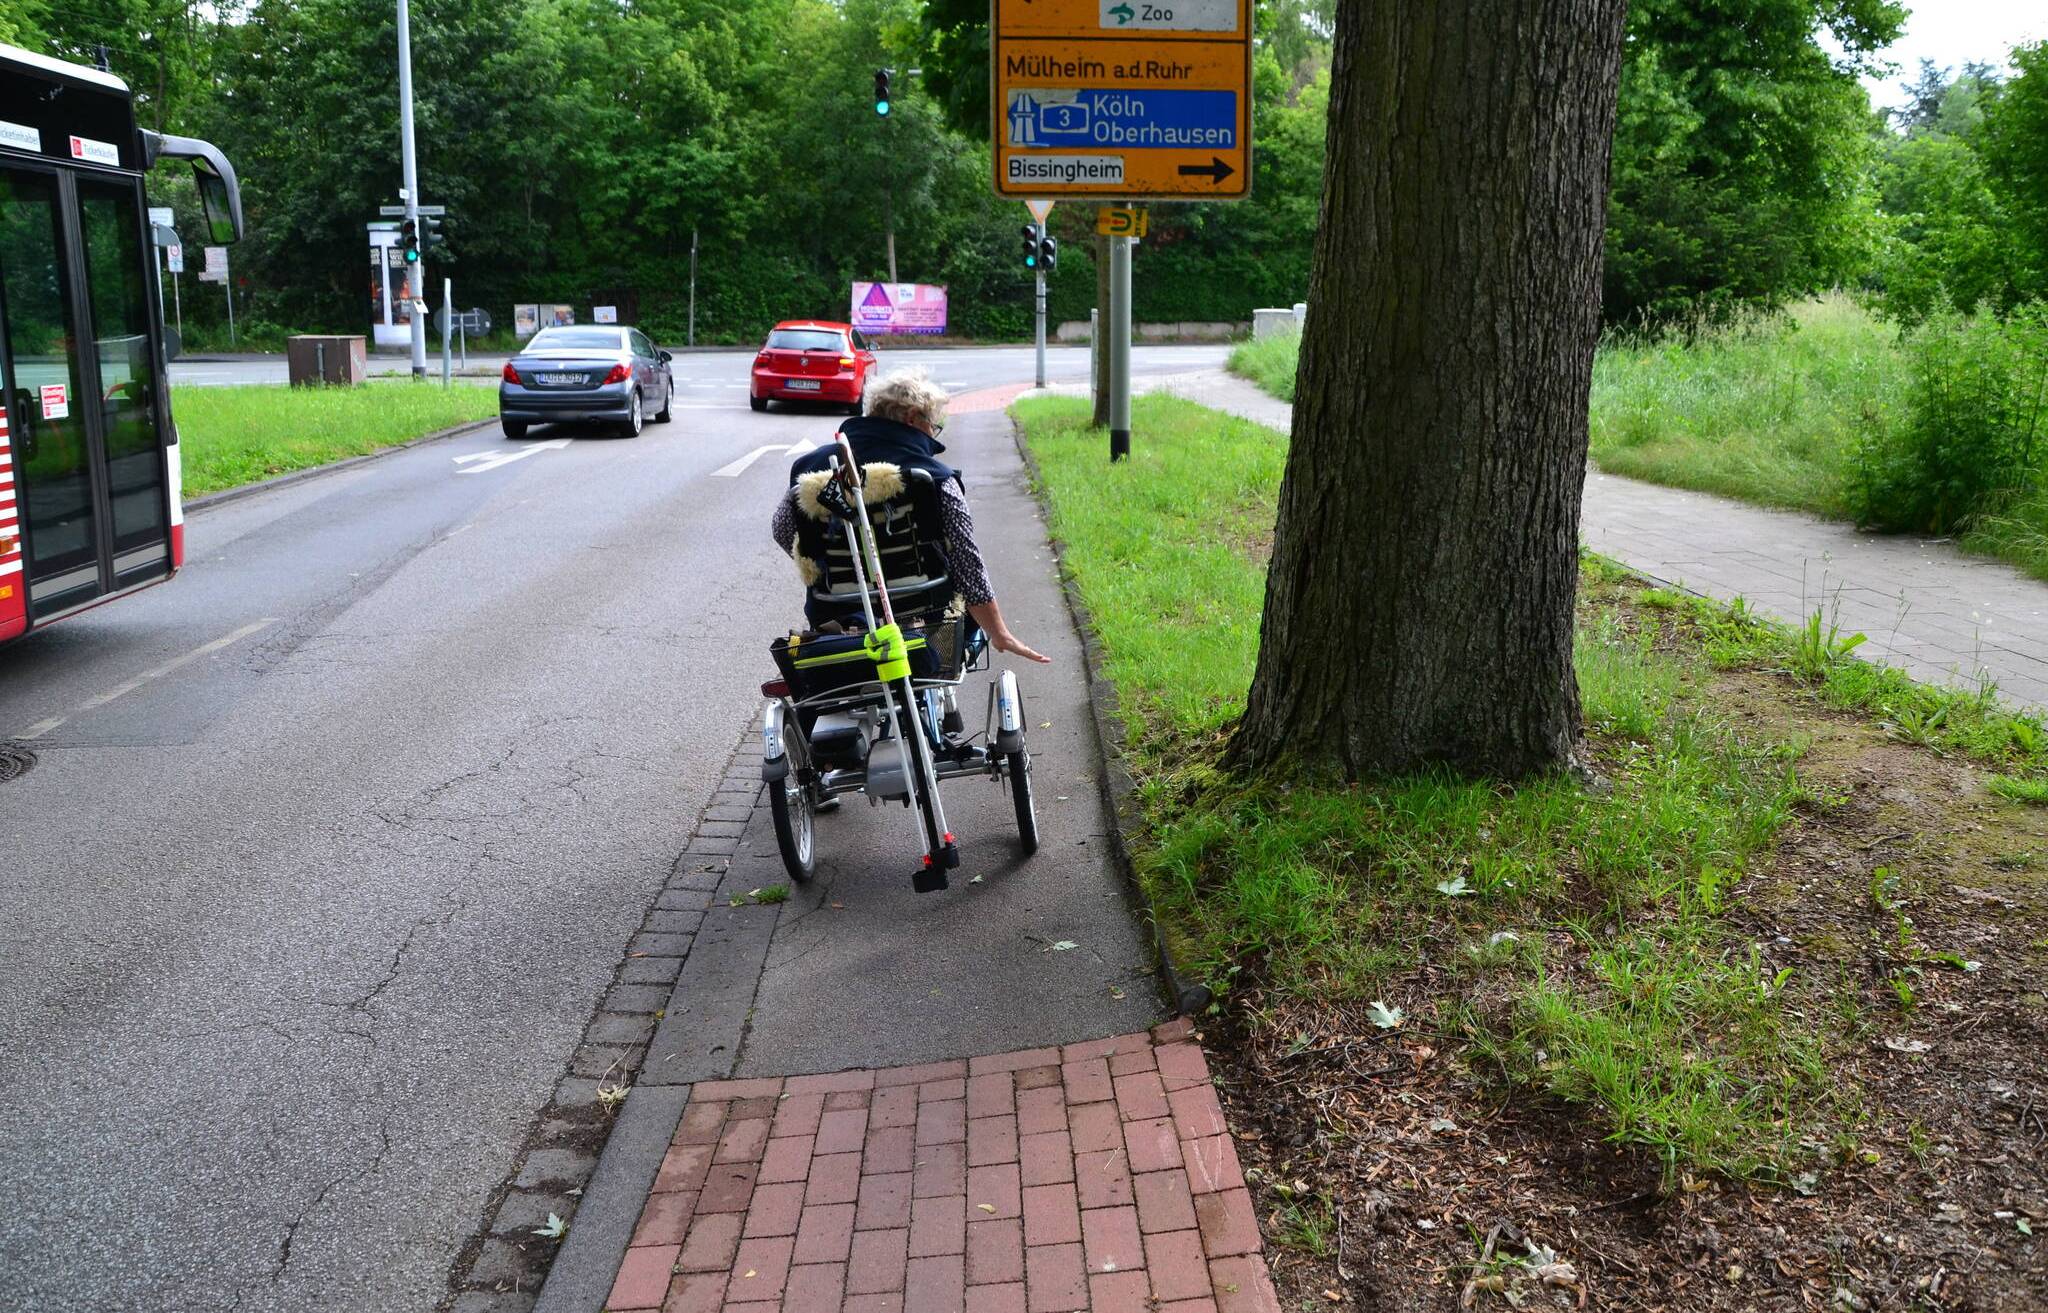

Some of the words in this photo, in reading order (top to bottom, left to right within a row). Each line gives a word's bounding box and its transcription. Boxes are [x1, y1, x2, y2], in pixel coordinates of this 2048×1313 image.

[1141, 5, 1173, 21] Zoo
[1006, 56, 1105, 79] Mülheim
[1093, 94, 1144, 117] Köln
[1059, 109, 1070, 127] 3
[1093, 120, 1232, 145] Oberhausen
[1008, 159, 1123, 182] Bissingheim
